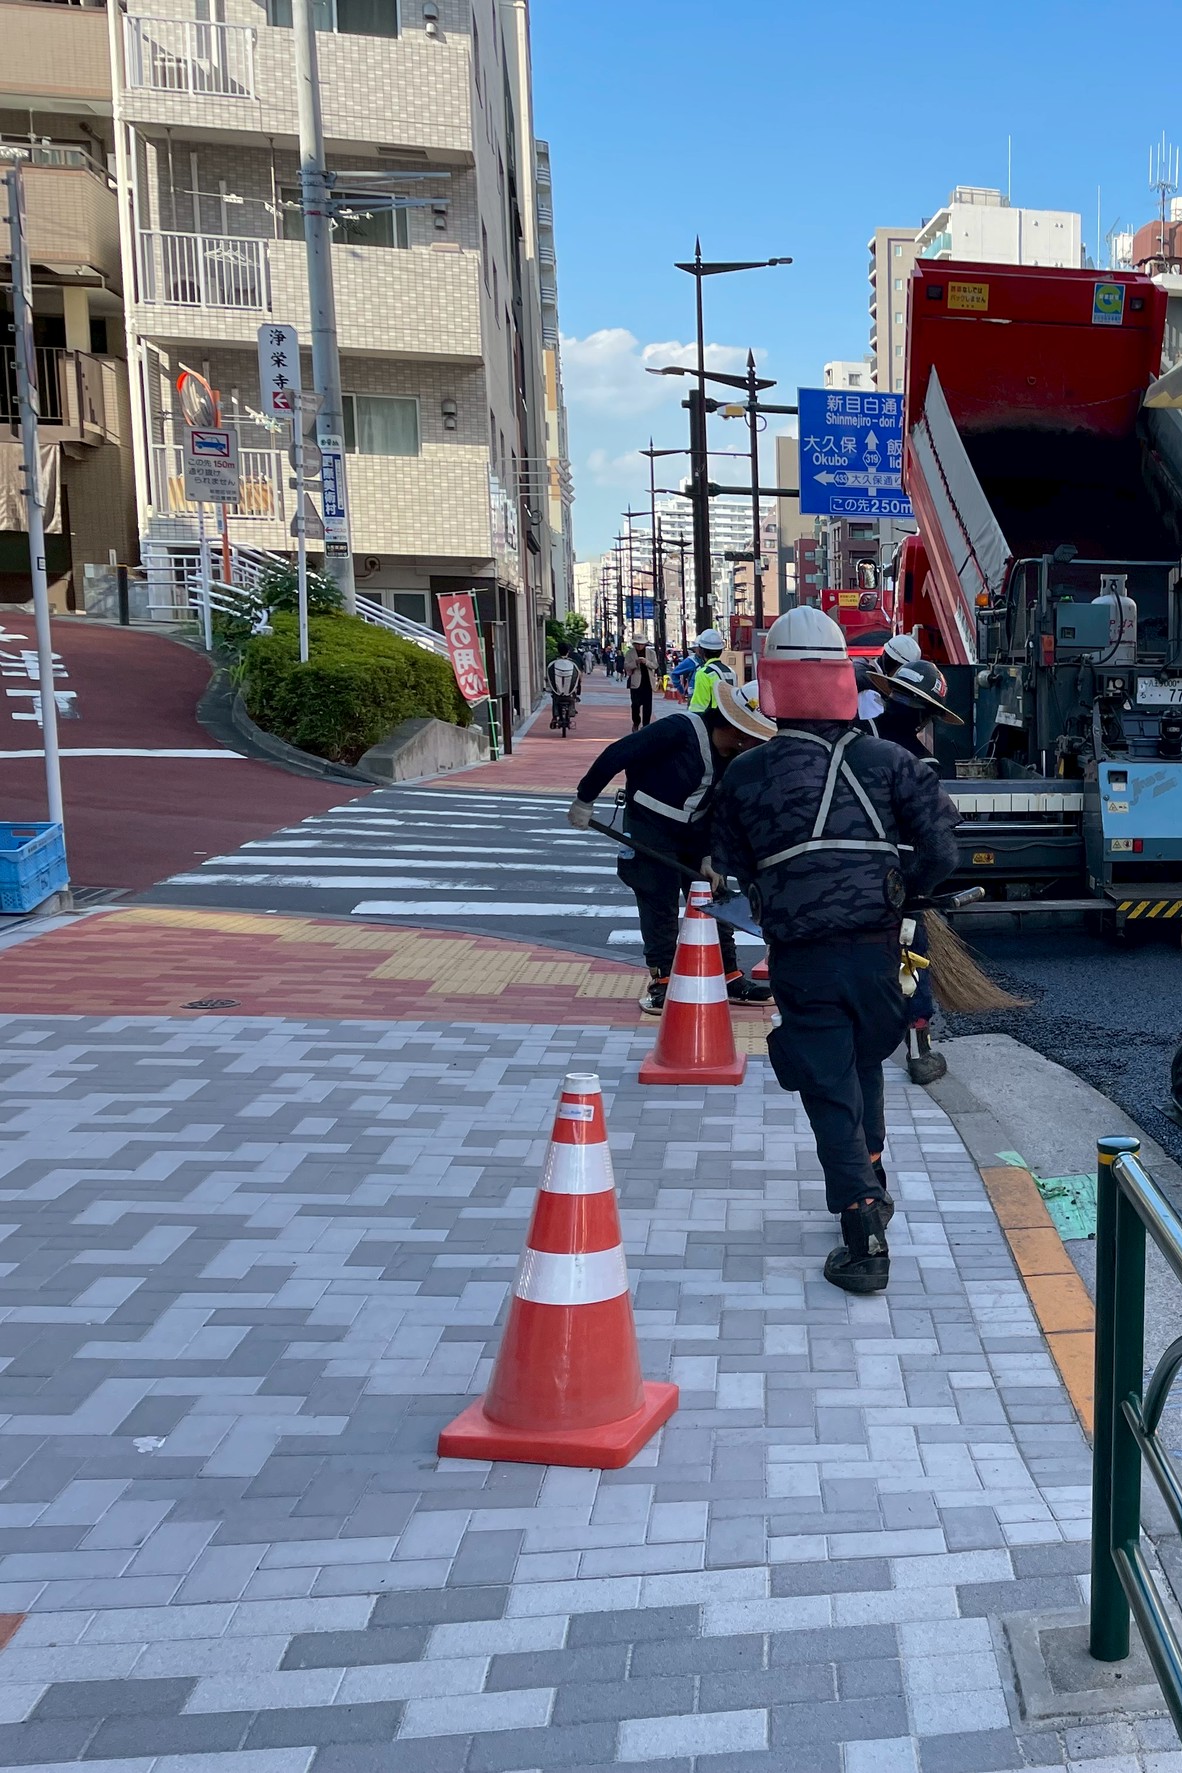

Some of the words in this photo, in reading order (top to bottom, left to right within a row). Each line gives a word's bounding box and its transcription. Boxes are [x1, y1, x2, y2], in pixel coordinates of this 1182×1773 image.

[269, 328, 290, 390] 浄栄寺
[803, 435, 857, 454] 大久保
[213, 460, 235, 468] 150m
[812, 452, 849, 466] Okubo
[865, 454, 879, 464] 319
[188, 468, 221, 477] 通り抜け
[194, 477, 236, 486] られません
[834, 474, 848, 484] 433
